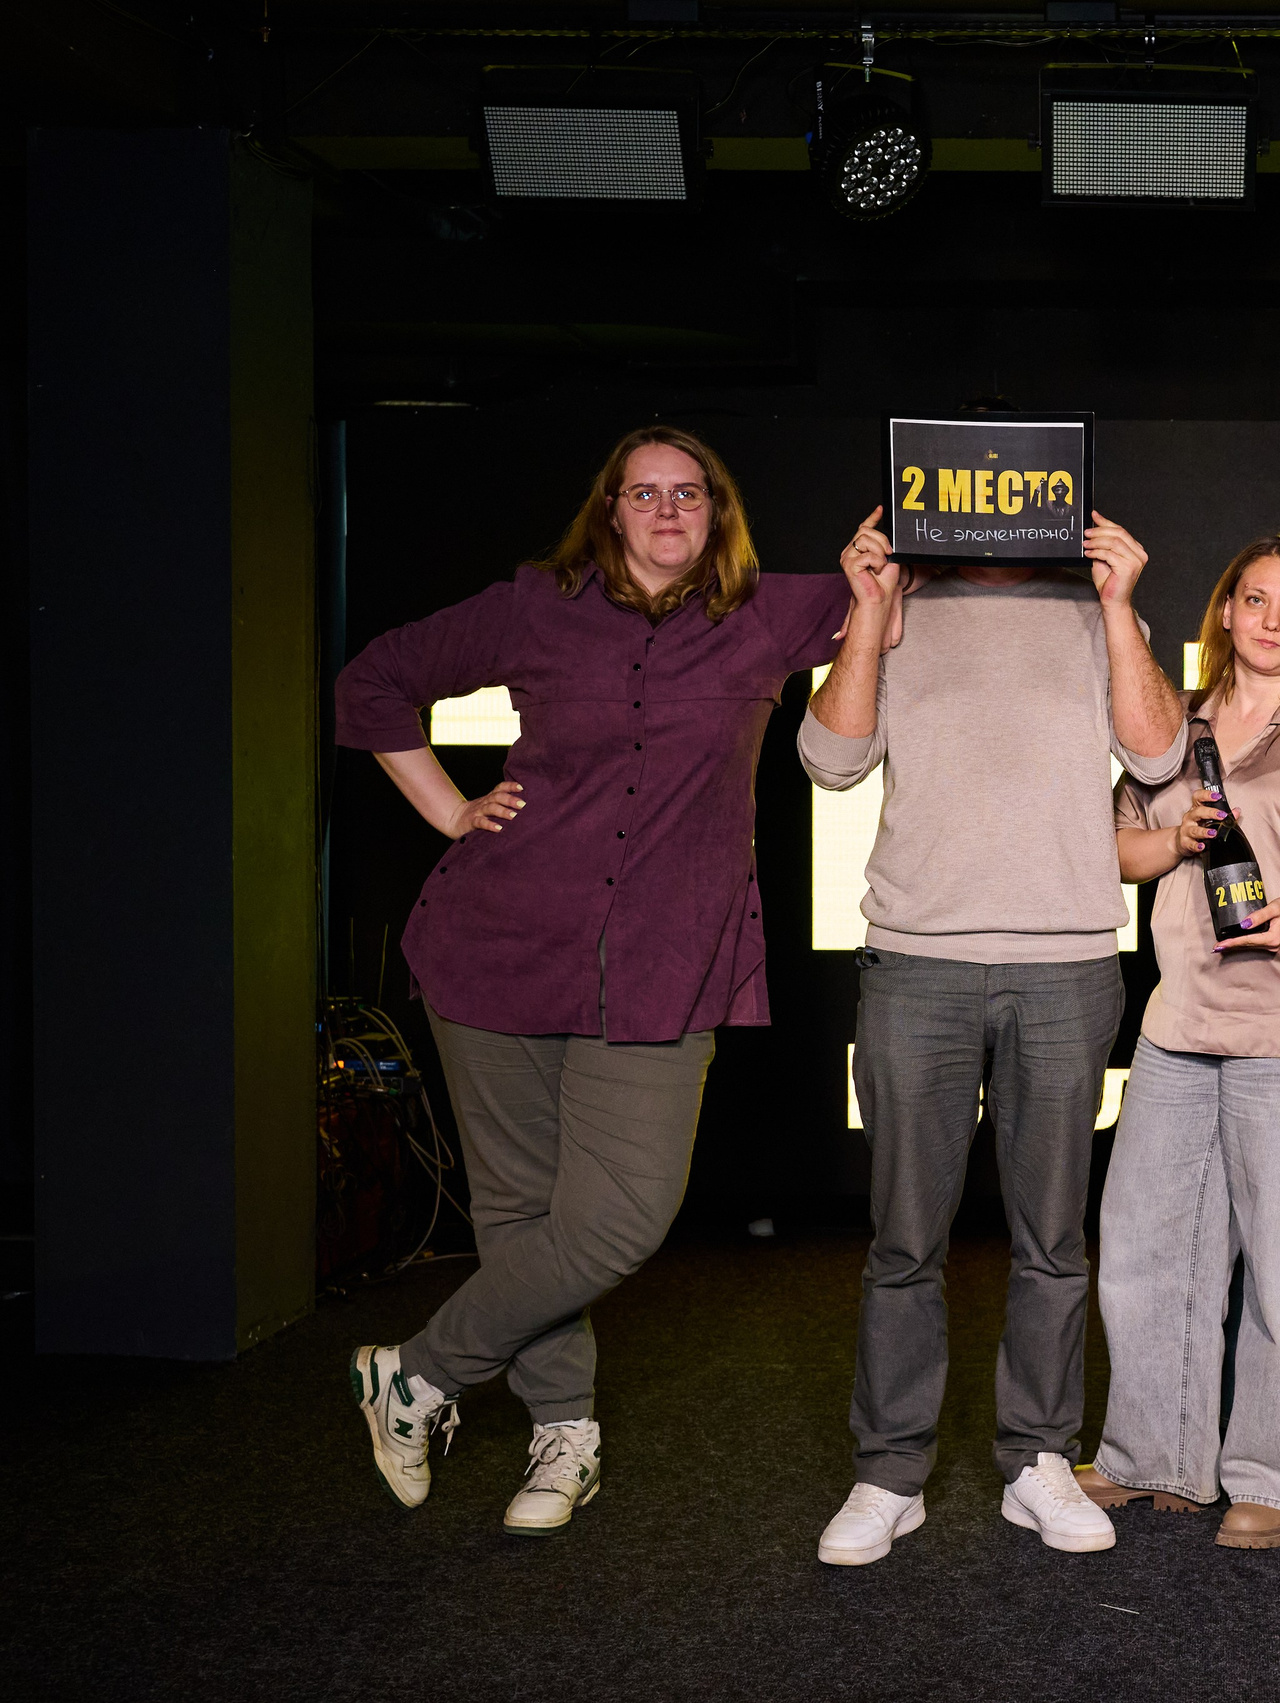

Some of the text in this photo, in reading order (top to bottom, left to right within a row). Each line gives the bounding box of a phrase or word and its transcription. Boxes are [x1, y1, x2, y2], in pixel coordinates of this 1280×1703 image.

[902, 466, 1073, 516] 2 МЕСТО
[915, 516, 1075, 542] Не элементарно!
[1215, 880, 1264, 907] 2 МЕС
